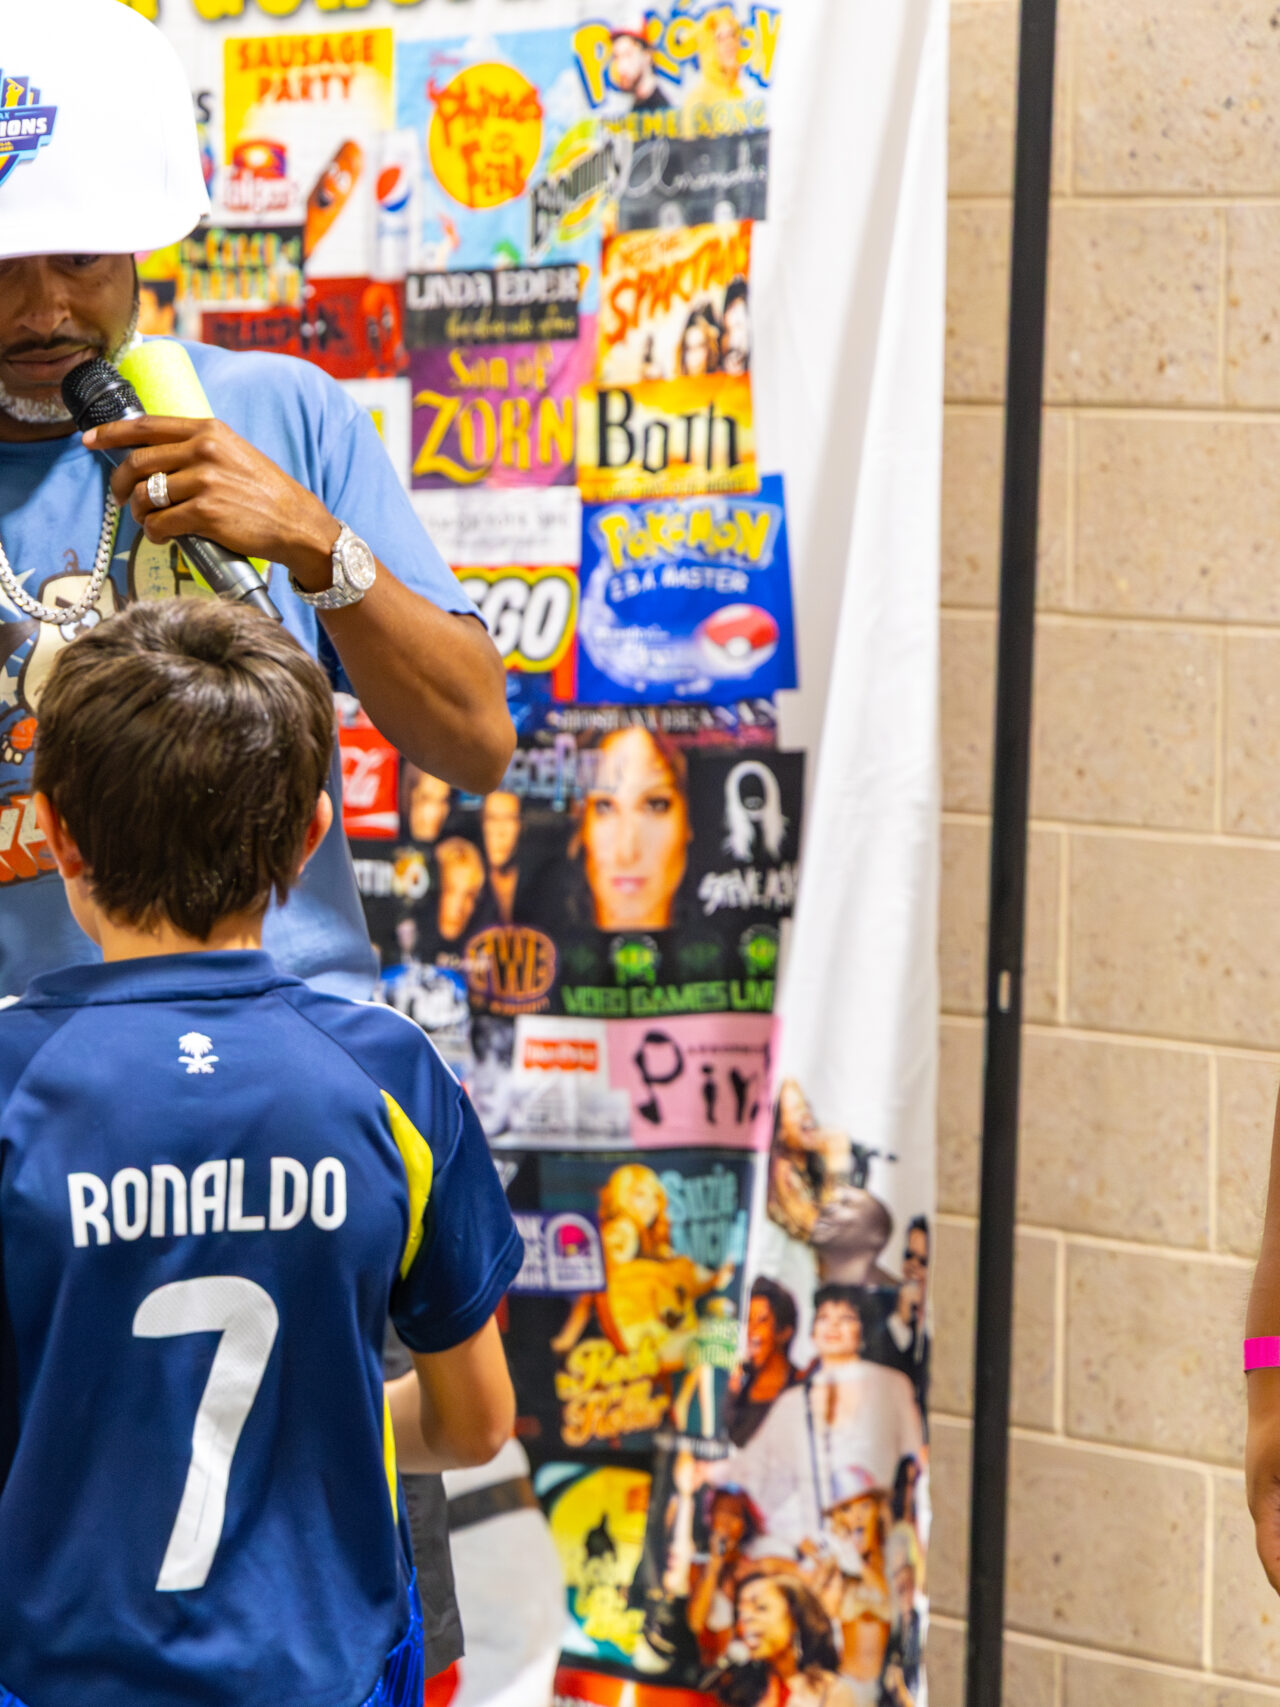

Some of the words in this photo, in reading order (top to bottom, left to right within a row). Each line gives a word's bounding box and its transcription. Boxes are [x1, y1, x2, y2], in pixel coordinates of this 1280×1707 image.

[239, 34, 375, 72] SAUSAGE
[258, 73, 354, 106] PARTY
[406, 272, 493, 311] LINDA
[497, 266, 579, 307] EDER
[411, 389, 575, 485] ZORN
[660, 563, 750, 595] MASTER
[461, 577, 571, 662] GO
[561, 985, 628, 1015] VIDEO
[630, 981, 728, 1015] GAMES
[67, 1156, 348, 1248] RONALDO
[132, 1275, 280, 1593] 7
